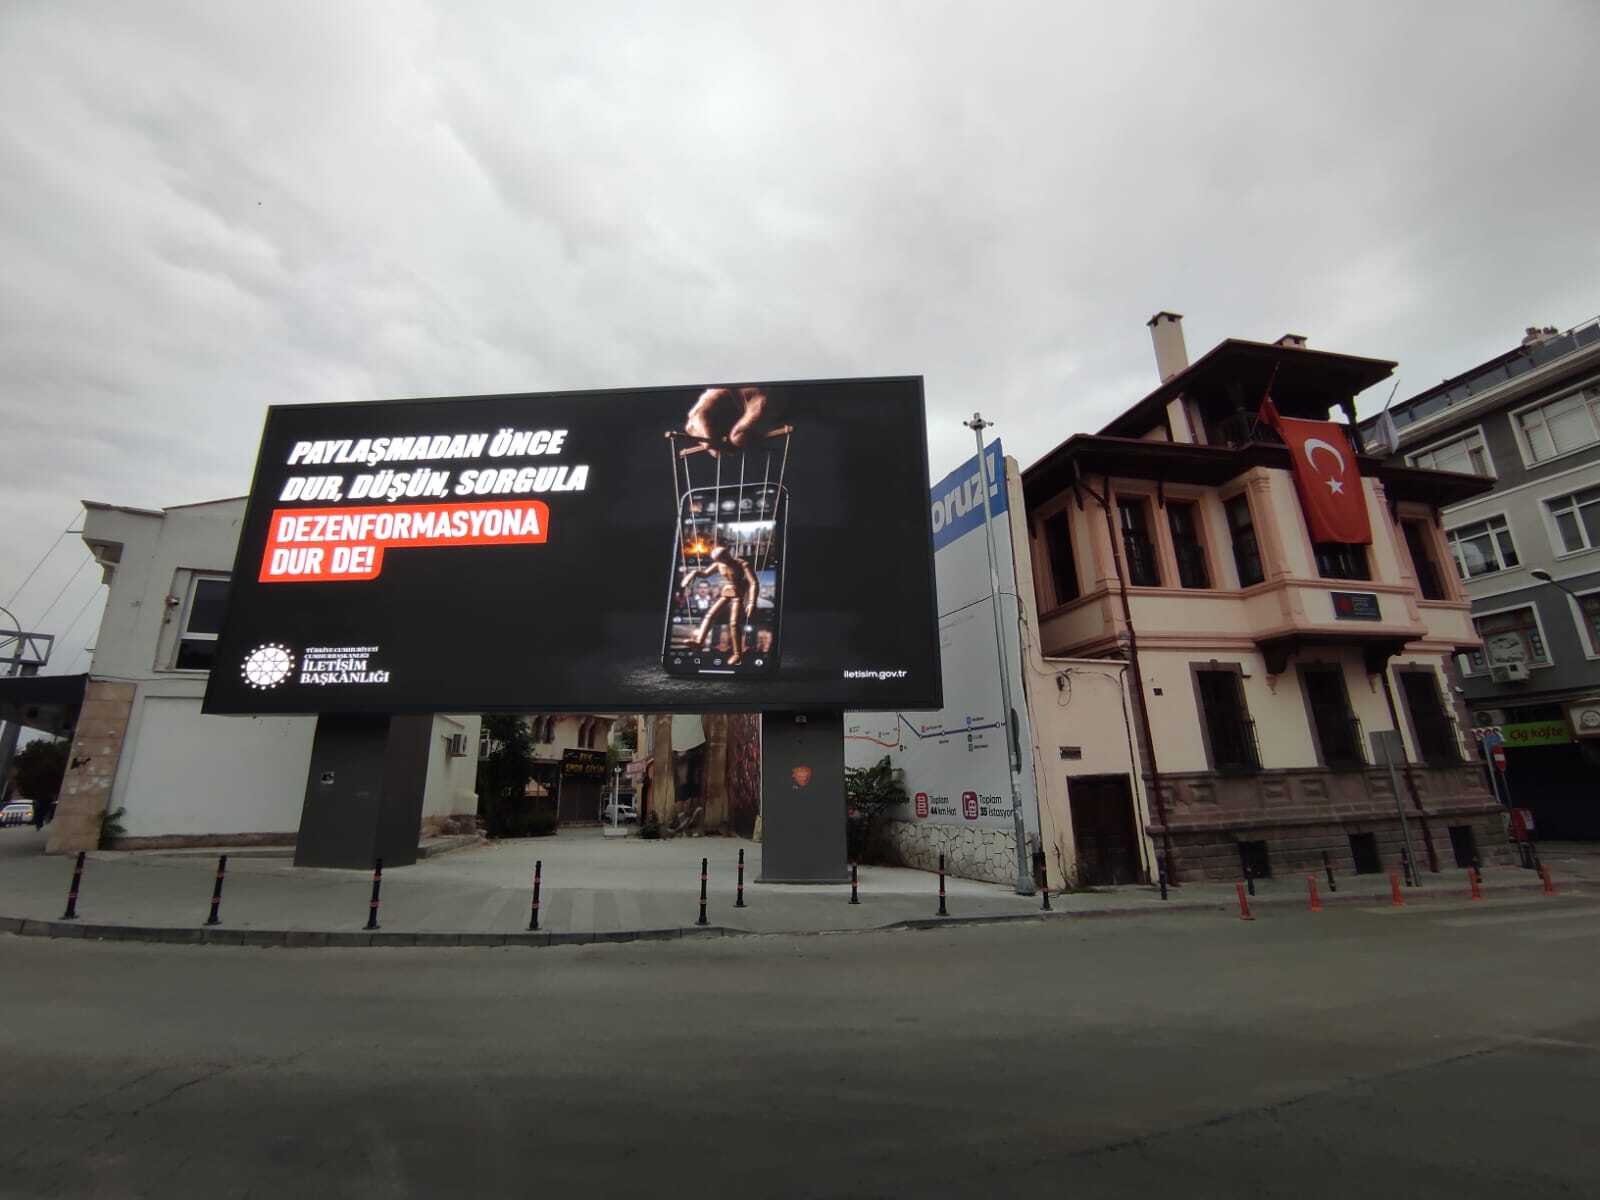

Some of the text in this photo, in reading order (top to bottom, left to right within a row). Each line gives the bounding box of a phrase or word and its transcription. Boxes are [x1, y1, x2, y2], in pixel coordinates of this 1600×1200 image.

[287, 429, 568, 466] PAYLAŞMADAN ÖNCE
[279, 465, 590, 502] DUR, DÜŞÜN, SORGULA
[276, 508, 540, 543] DEZENFORMASYONA
[270, 545, 376, 576] DUR DE!
[300, 670, 390, 686] BAŞKANLIĞI
[302, 658, 367, 672] İLETİŞİM
[979, 794, 1002, 805] Toplam
